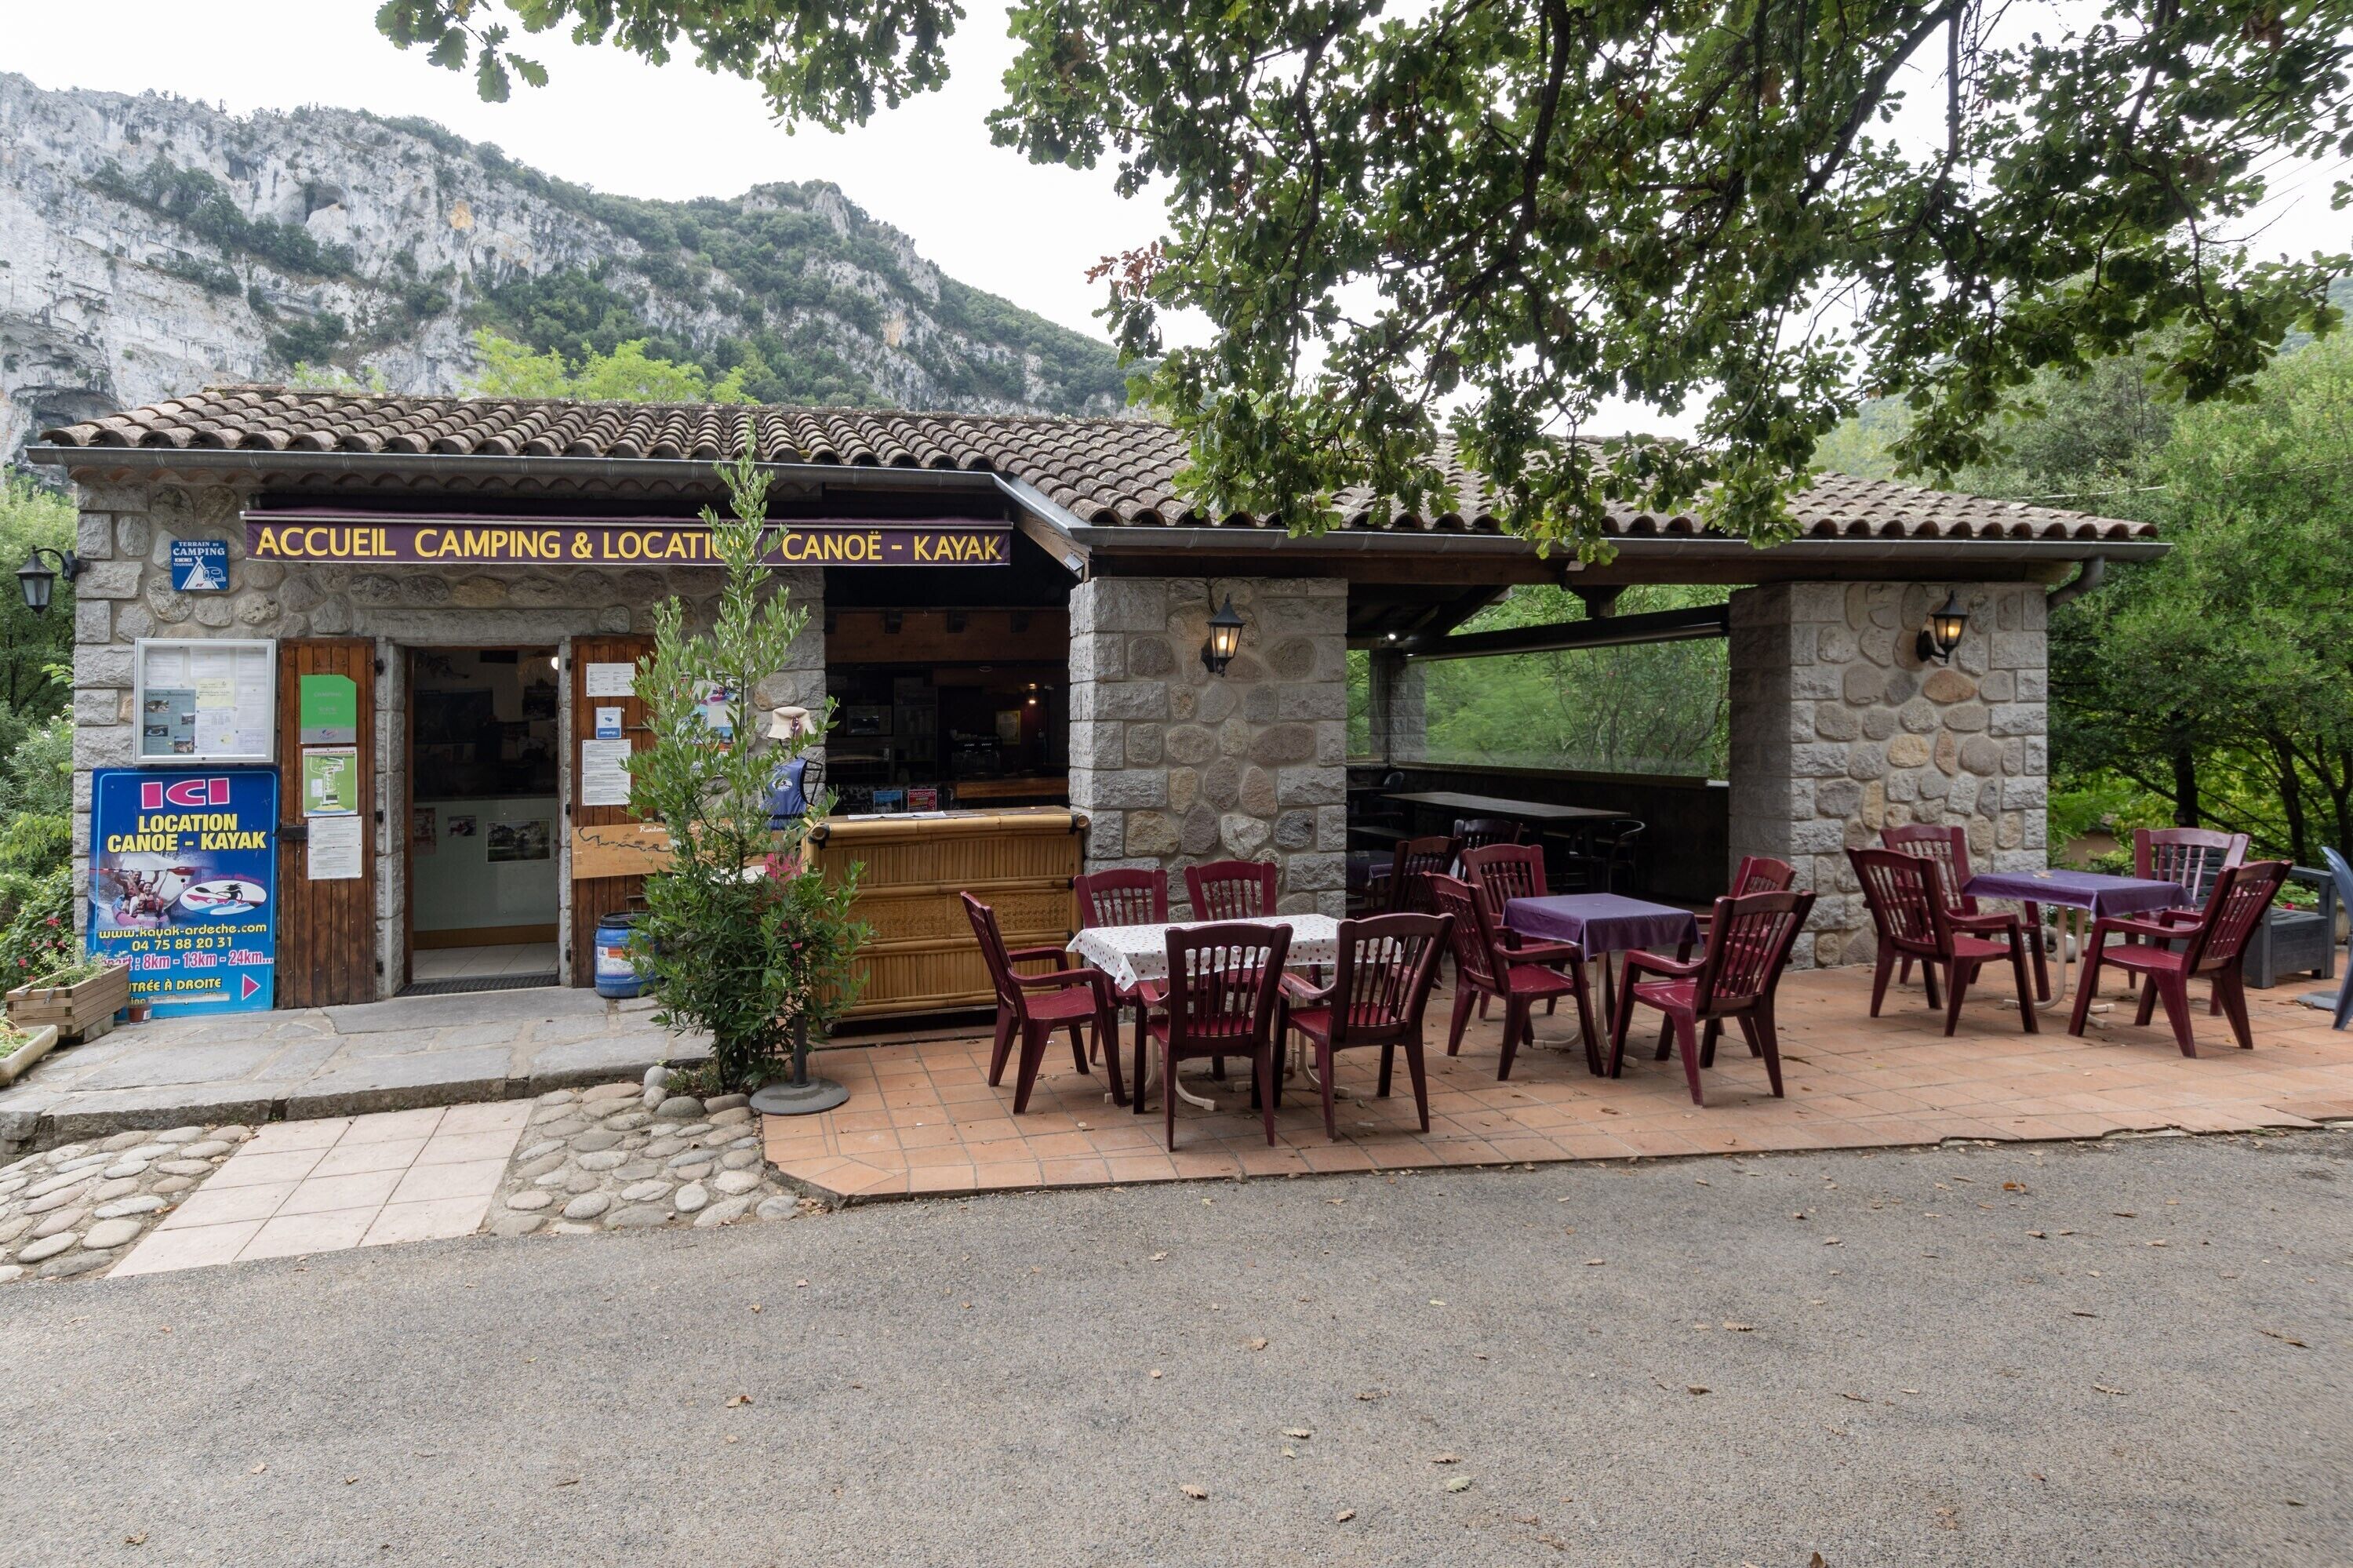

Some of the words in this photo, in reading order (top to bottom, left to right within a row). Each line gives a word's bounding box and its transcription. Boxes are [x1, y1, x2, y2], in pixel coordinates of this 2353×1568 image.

[173, 548, 225, 556] CAMPING
[256, 527, 396, 556] ACCUEIL
[414, 529, 561, 558] CAMPING
[571, 533, 593, 558] &
[603, 531, 755, 560] LOCATI
[782, 530, 882, 561] CANOË
[914, 535, 1002, 561] KAYAK
[141, 777, 230, 809] ICI
[138, 813, 238, 833] LOCATION
[107, 834, 178, 853] CANOE
[200, 831, 267, 850] KAYAK
[99, 923, 267, 940] www.kayak-ardeche.com
[132, 940, 149, 951] 04
[155, 940, 170, 951] 75
[175, 938, 192, 950] 88
[196, 937, 213, 949] 20
[217, 937, 232, 948] 31
[143, 953, 170, 970] 8km
[183, 951, 217, 968] 13km
[228, 949, 274, 965] 24km...
[129, 979, 162, 993] TRÉE
[164, 978, 173, 991] À
[176, 978, 222, 990] DROITE
